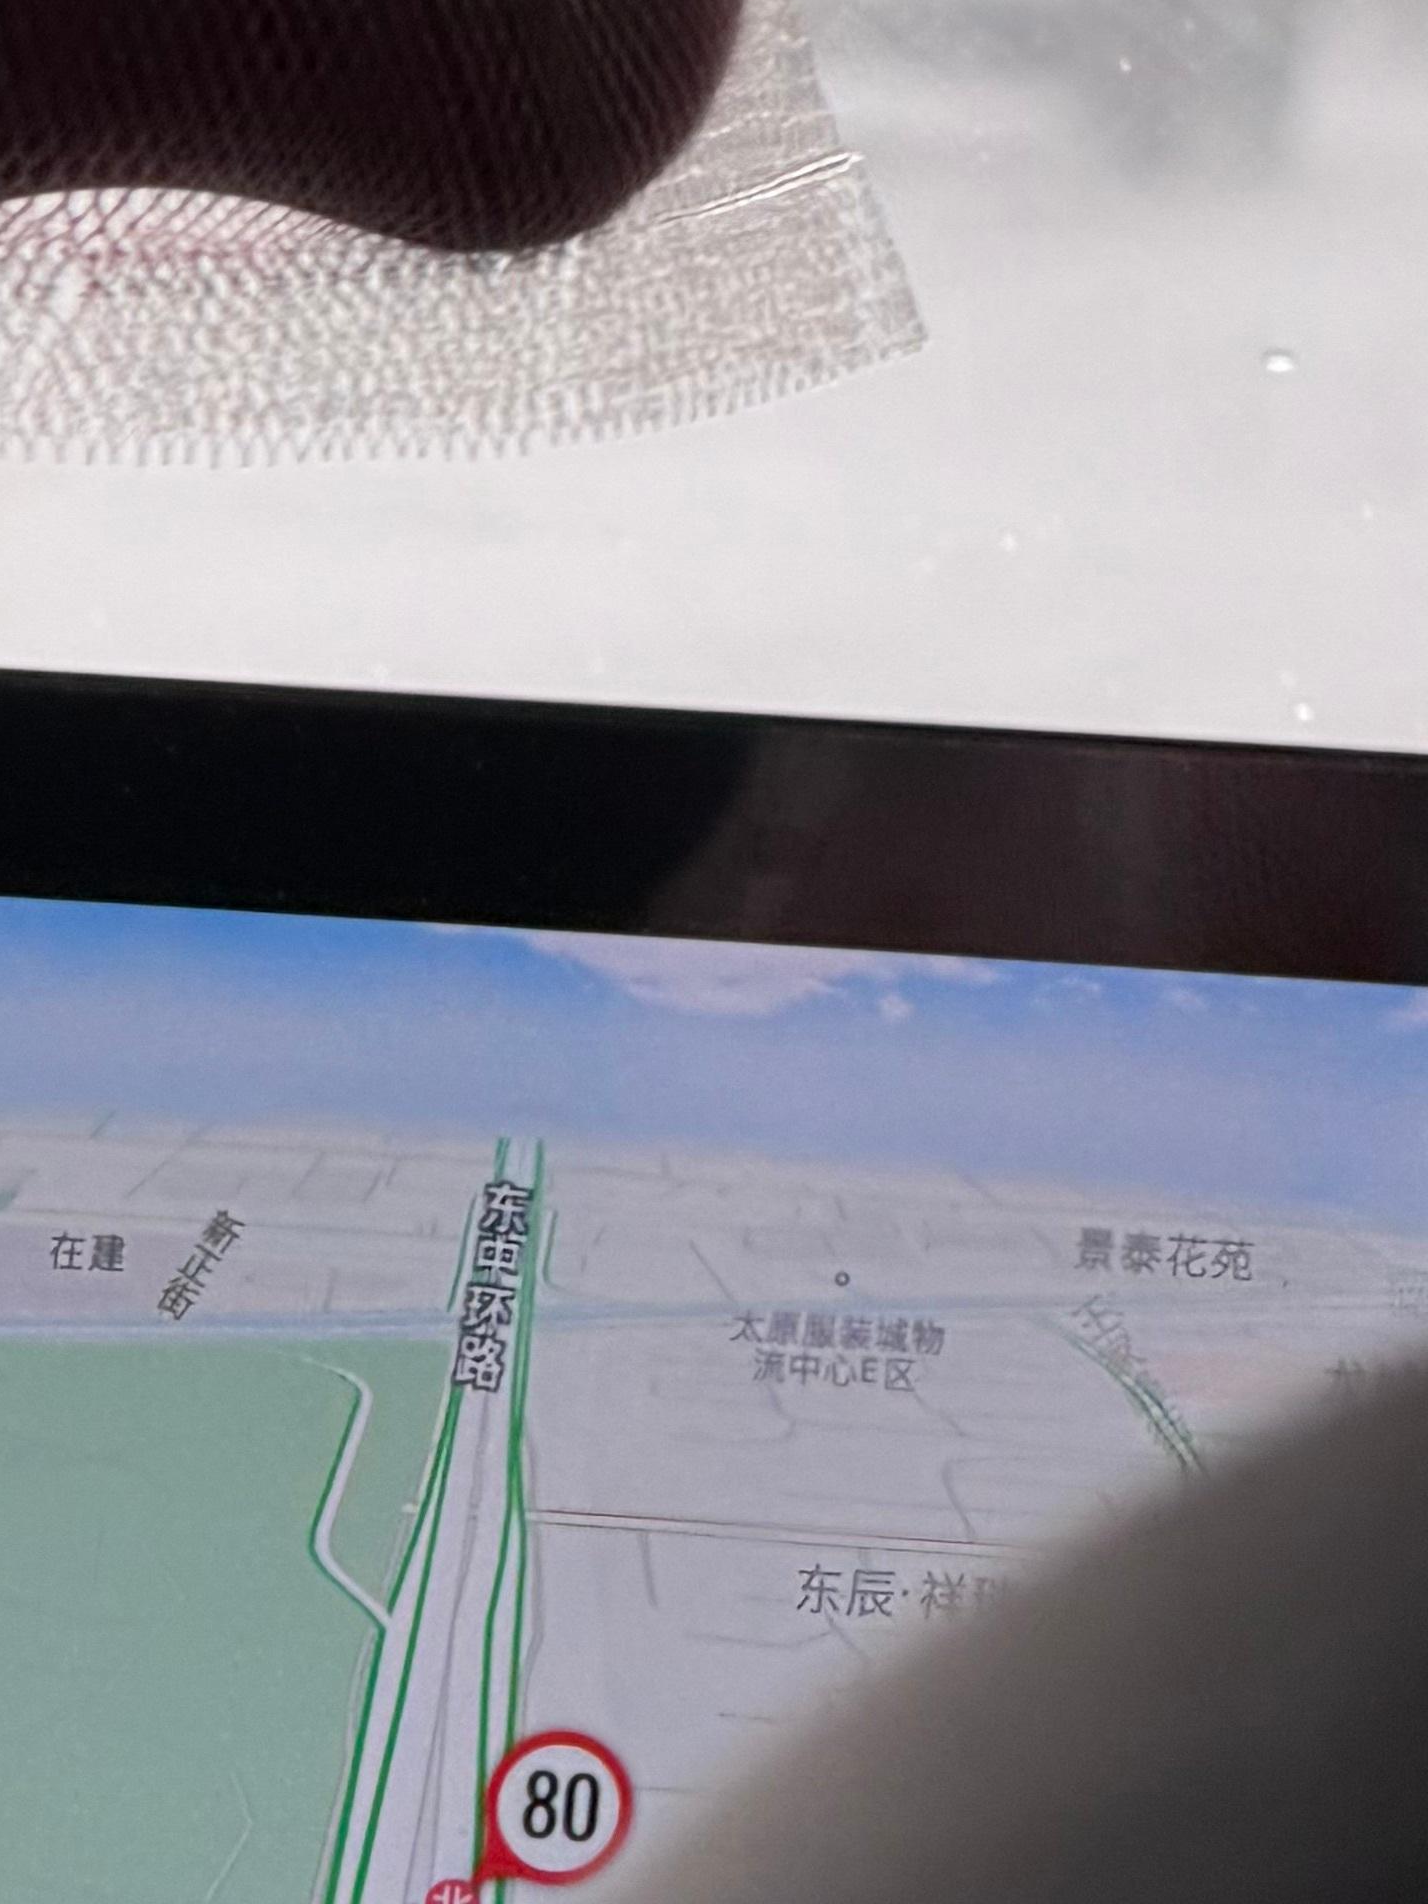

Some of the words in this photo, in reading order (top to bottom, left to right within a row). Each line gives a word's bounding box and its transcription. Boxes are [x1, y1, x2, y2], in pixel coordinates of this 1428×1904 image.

[50, 1231, 125, 1273] 在建
[1073, 1227, 1255, 1281] 景泰花苑
[451, 1180, 533, 1393] 东中环路
[523, 1769, 600, 1842] 80
